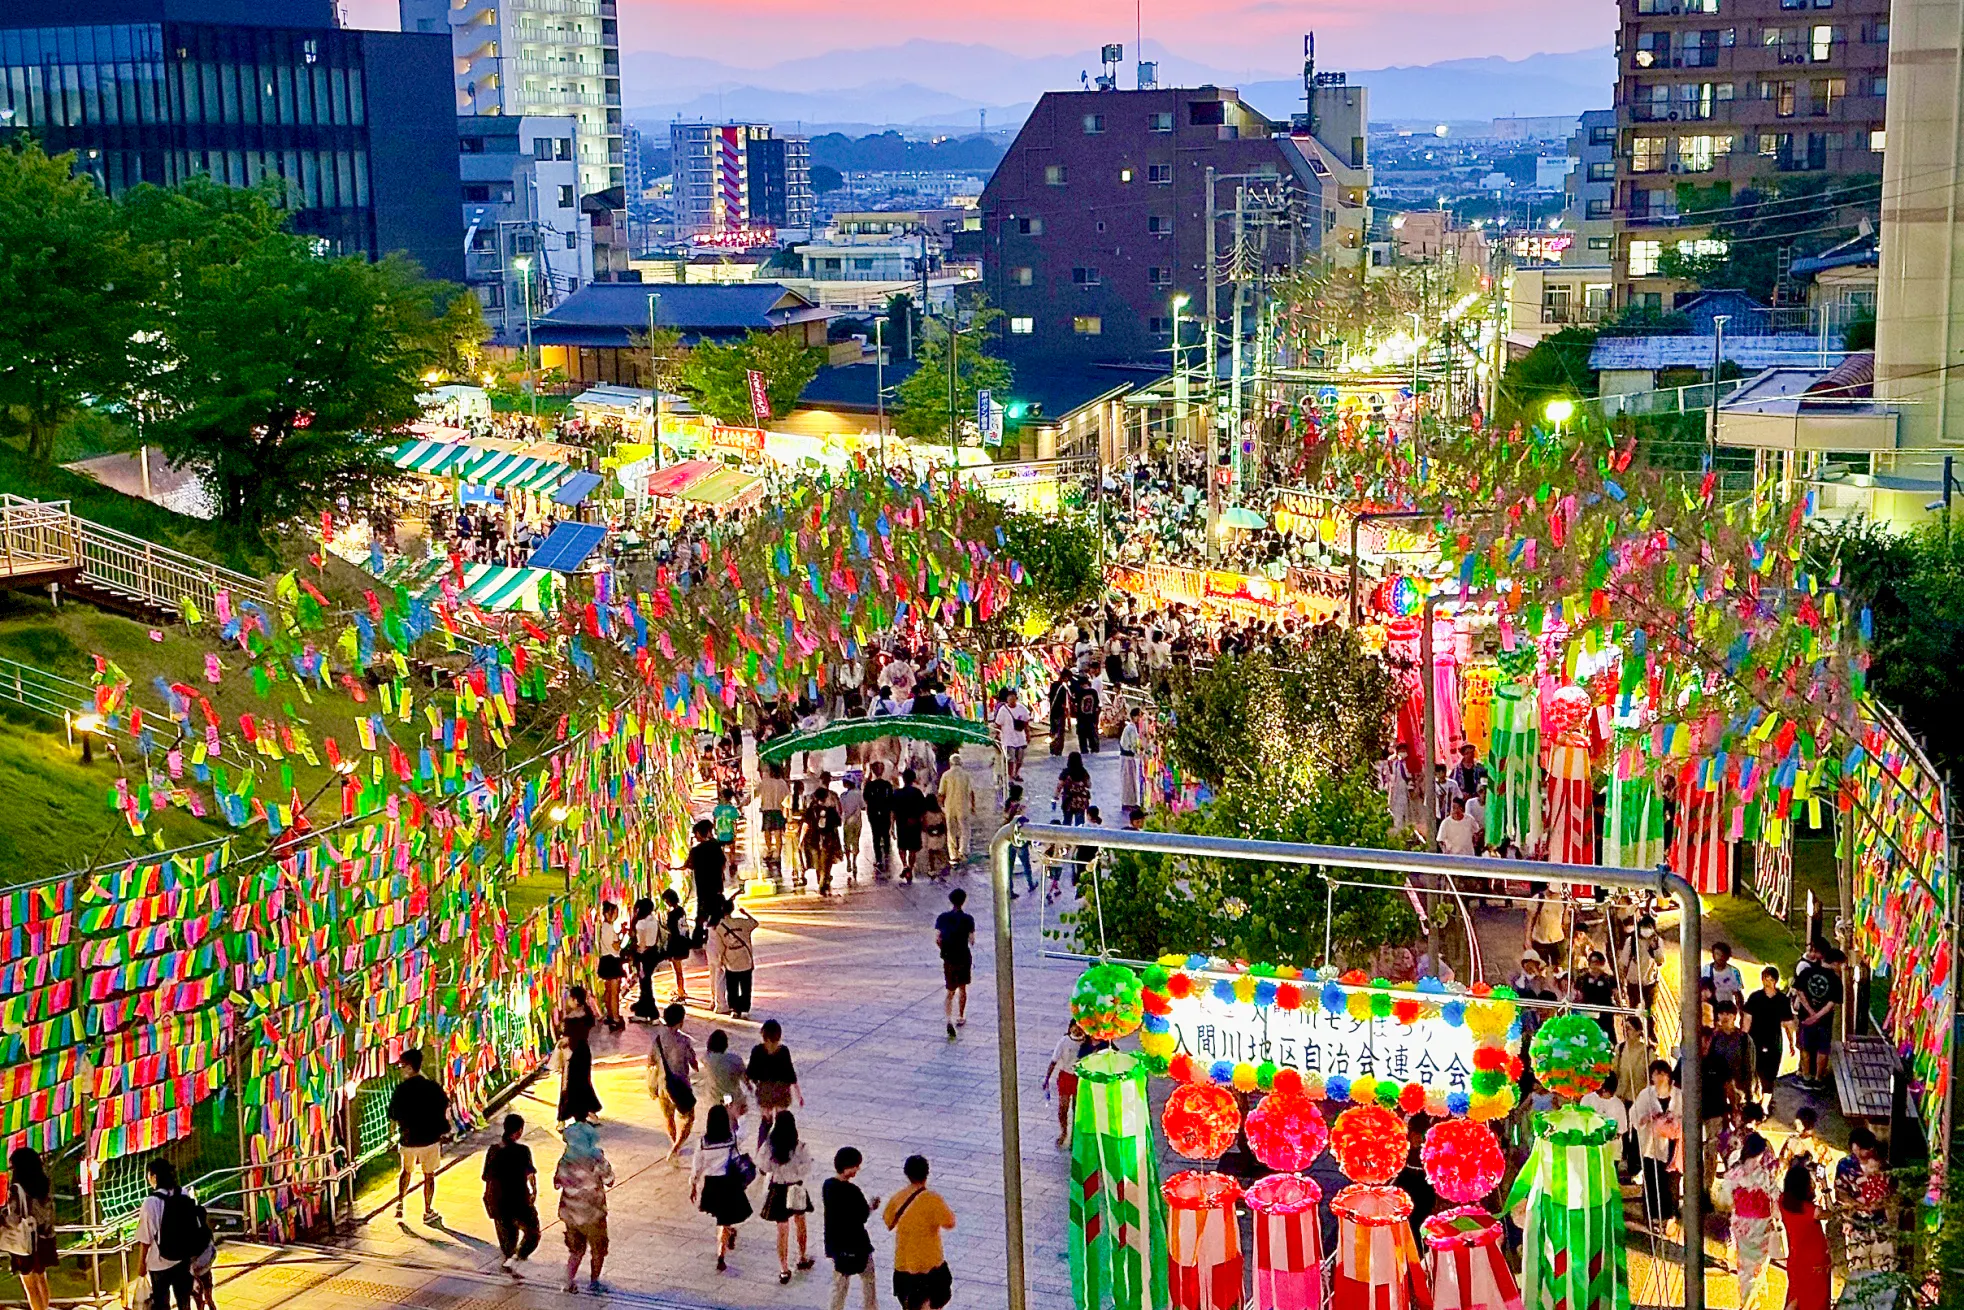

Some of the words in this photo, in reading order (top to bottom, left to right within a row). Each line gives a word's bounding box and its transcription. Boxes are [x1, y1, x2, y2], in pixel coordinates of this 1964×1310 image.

[1173, 1023, 1471, 1091] 入間川地区自治会連合会
